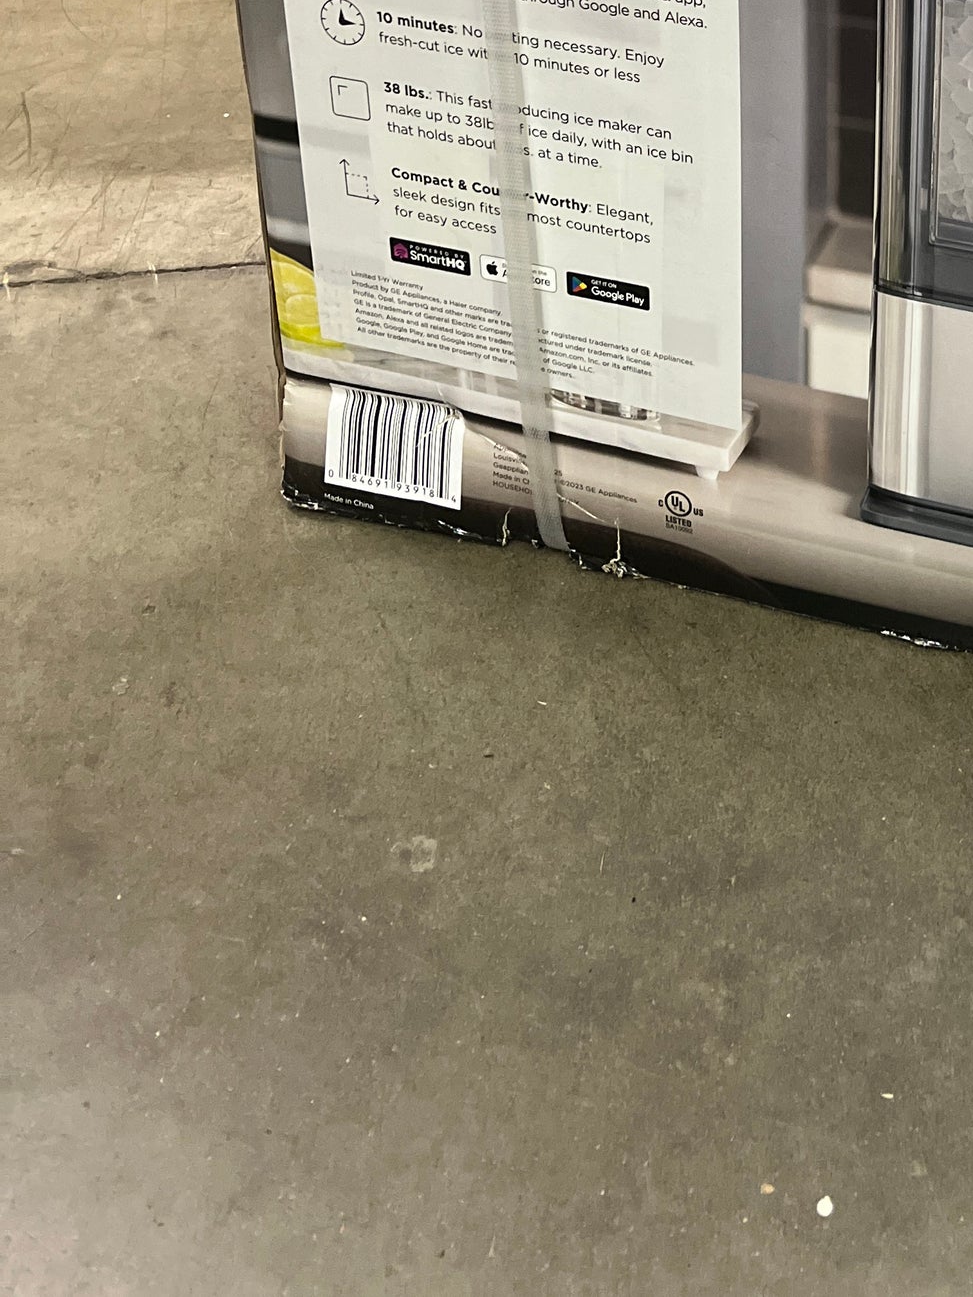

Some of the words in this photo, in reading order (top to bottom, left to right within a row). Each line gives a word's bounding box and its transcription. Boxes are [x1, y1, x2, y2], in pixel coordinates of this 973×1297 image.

[376, 10, 392, 24] 10
[462, 24, 482, 38] No
[543, 38, 620, 60] necessary.
[625, 47, 664, 68] Enjoy
[633, 8, 660, 21] and
[664, 10, 707, 28] Alexa.
[378, 30, 440, 52] fresh-cut
[443, 41, 463, 55] ice
[513, 52, 529, 65] 10
[533, 56, 589, 75] minutes
[593, 67, 609, 77] or
[613, 66, 640, 83] less
[383, 81, 400, 94] 38
[435, 89, 464, 105] This
[574, 112, 593, 126] ice
[598, 119, 641, 133] maker
[646, 127, 671, 139] can
[385, 103, 421, 117] make
[425, 110, 442, 123] up
[446, 111, 460, 124] to
[464, 114, 494, 130] 38lb
[528, 124, 547, 139] ice
[551, 129, 587, 147] daily,
[590, 137, 621, 151] with
[625, 143, 642, 155] an
[646, 144, 666, 159] ice
[671, 148, 693, 164] bin
[386, 120, 414, 136] that
[417, 125, 453, 143] holds
[537, 148, 551, 159] at
[555, 152, 563, 161] a
[567, 152, 601, 168] time.
[390, 166, 453, 188] Compact
[457, 179, 467, 191] &
[596, 202, 653, 226] Elegant,
[392, 186, 427, 202] sleek
[430, 193, 475, 211] design
[479, 201, 500, 215] fits
[526, 212, 561, 227] most
[565, 219, 650, 243] countertops
[394, 204, 413, 218] for
[417, 211, 447, 226] easy
[451, 218, 496, 234] access
[410, 250, 467, 272] SmartHQ
[590, 285, 625, 302] Google
[625, 292, 645, 307] Play
[324, 492, 344, 503] Made
[353, 498, 375, 510] China
[665, 514, 692, 528] LISTED
